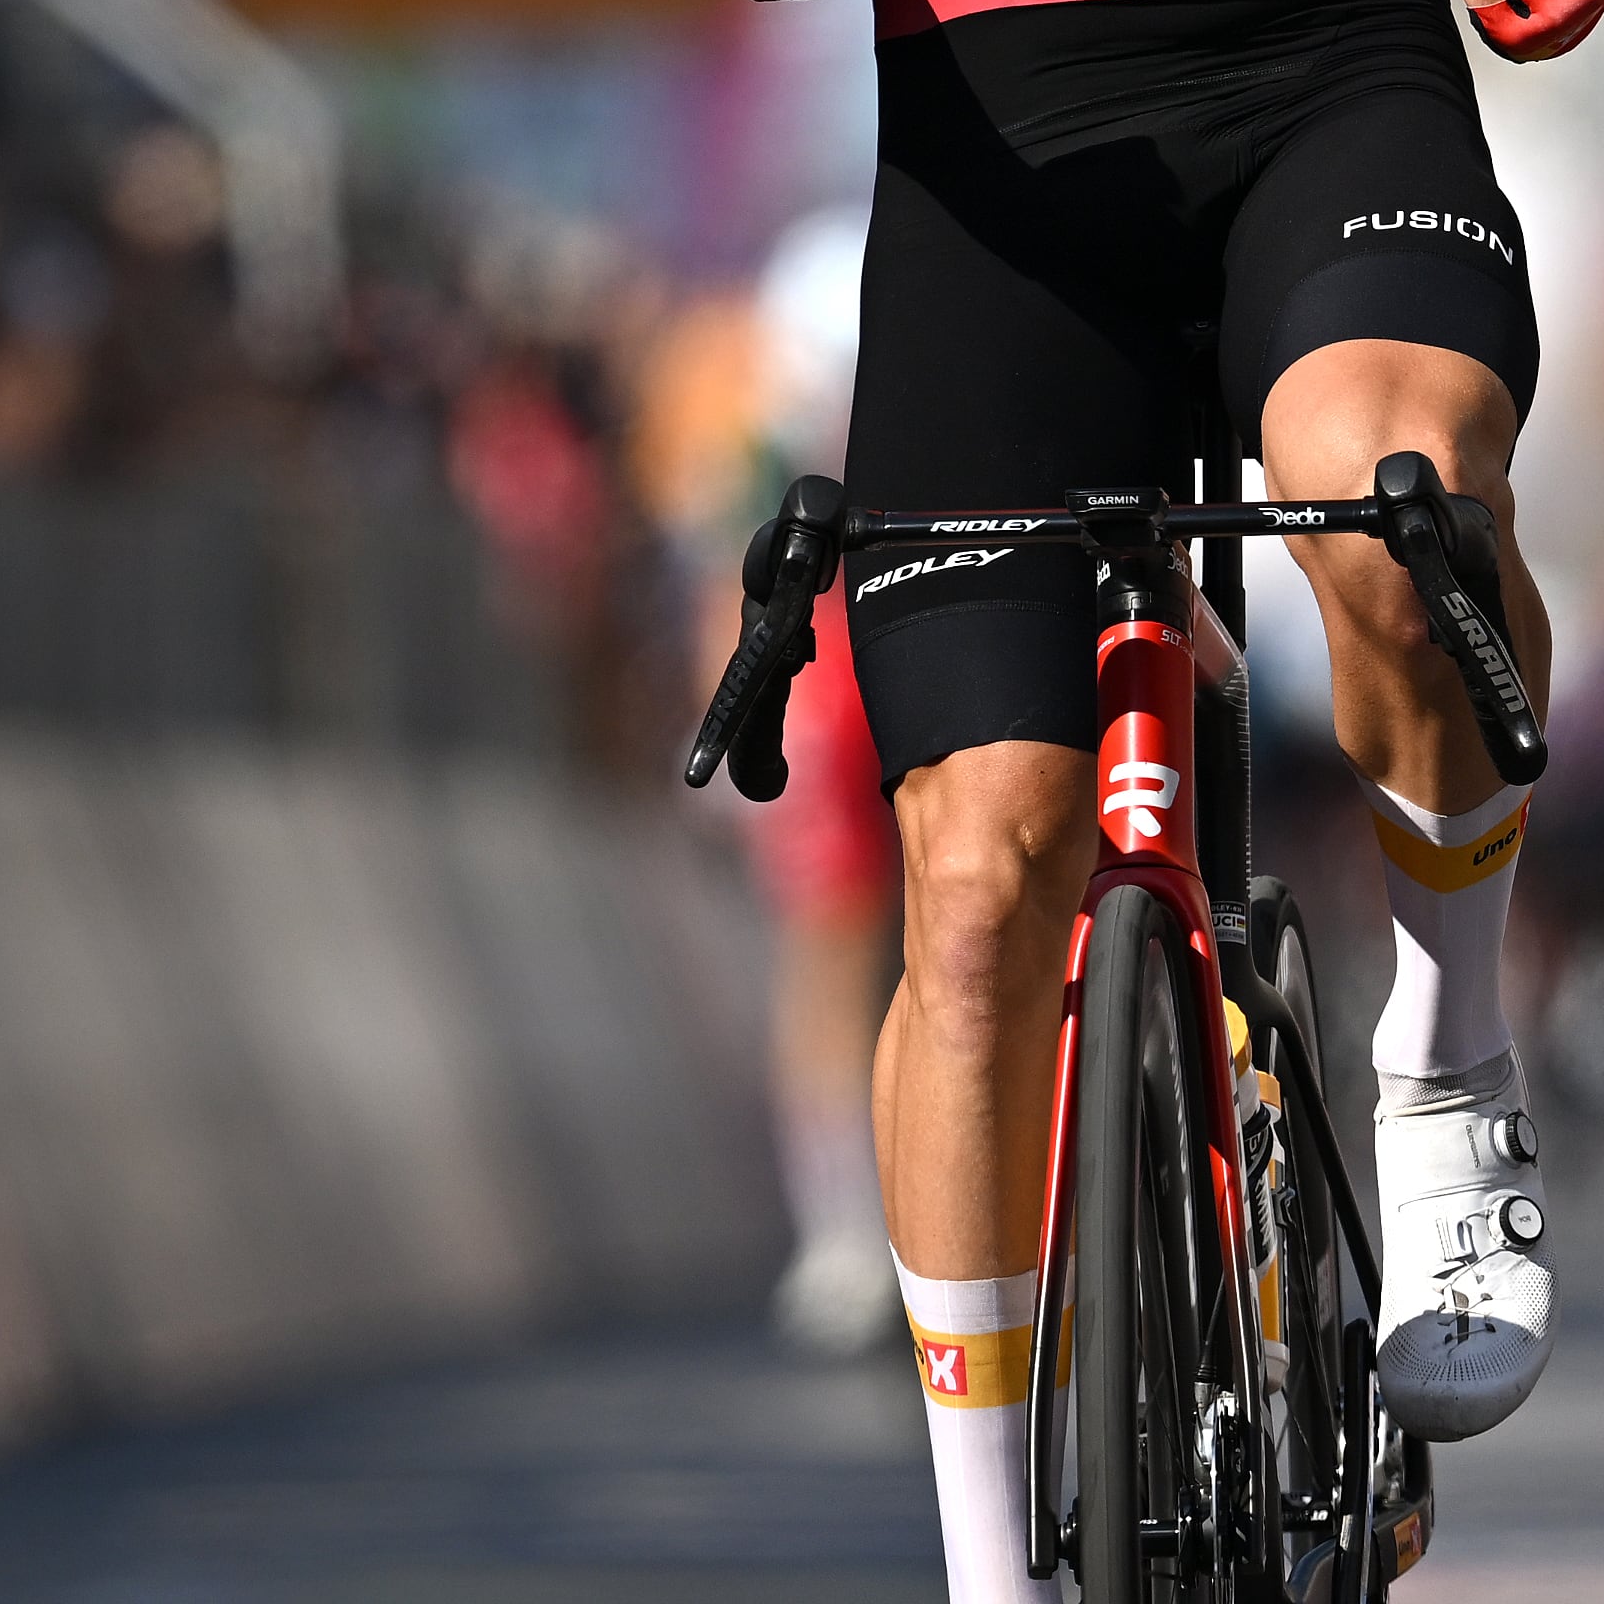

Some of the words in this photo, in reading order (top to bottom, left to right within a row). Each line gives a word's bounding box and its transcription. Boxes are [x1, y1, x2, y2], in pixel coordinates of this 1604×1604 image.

[1343, 210, 1514, 266] FUSION
[1087, 495, 1140, 505] GARMIN
[1257, 506, 1326, 527] Deda
[930, 518, 1048, 533] RIDLEY
[855, 548, 1016, 603] RIDLEY
[1160, 629, 1182, 646] SLT
[1441, 591, 1526, 713] SRAM
[1473, 827, 1518, 866] Uno
[926, 1348, 959, 1391] X
